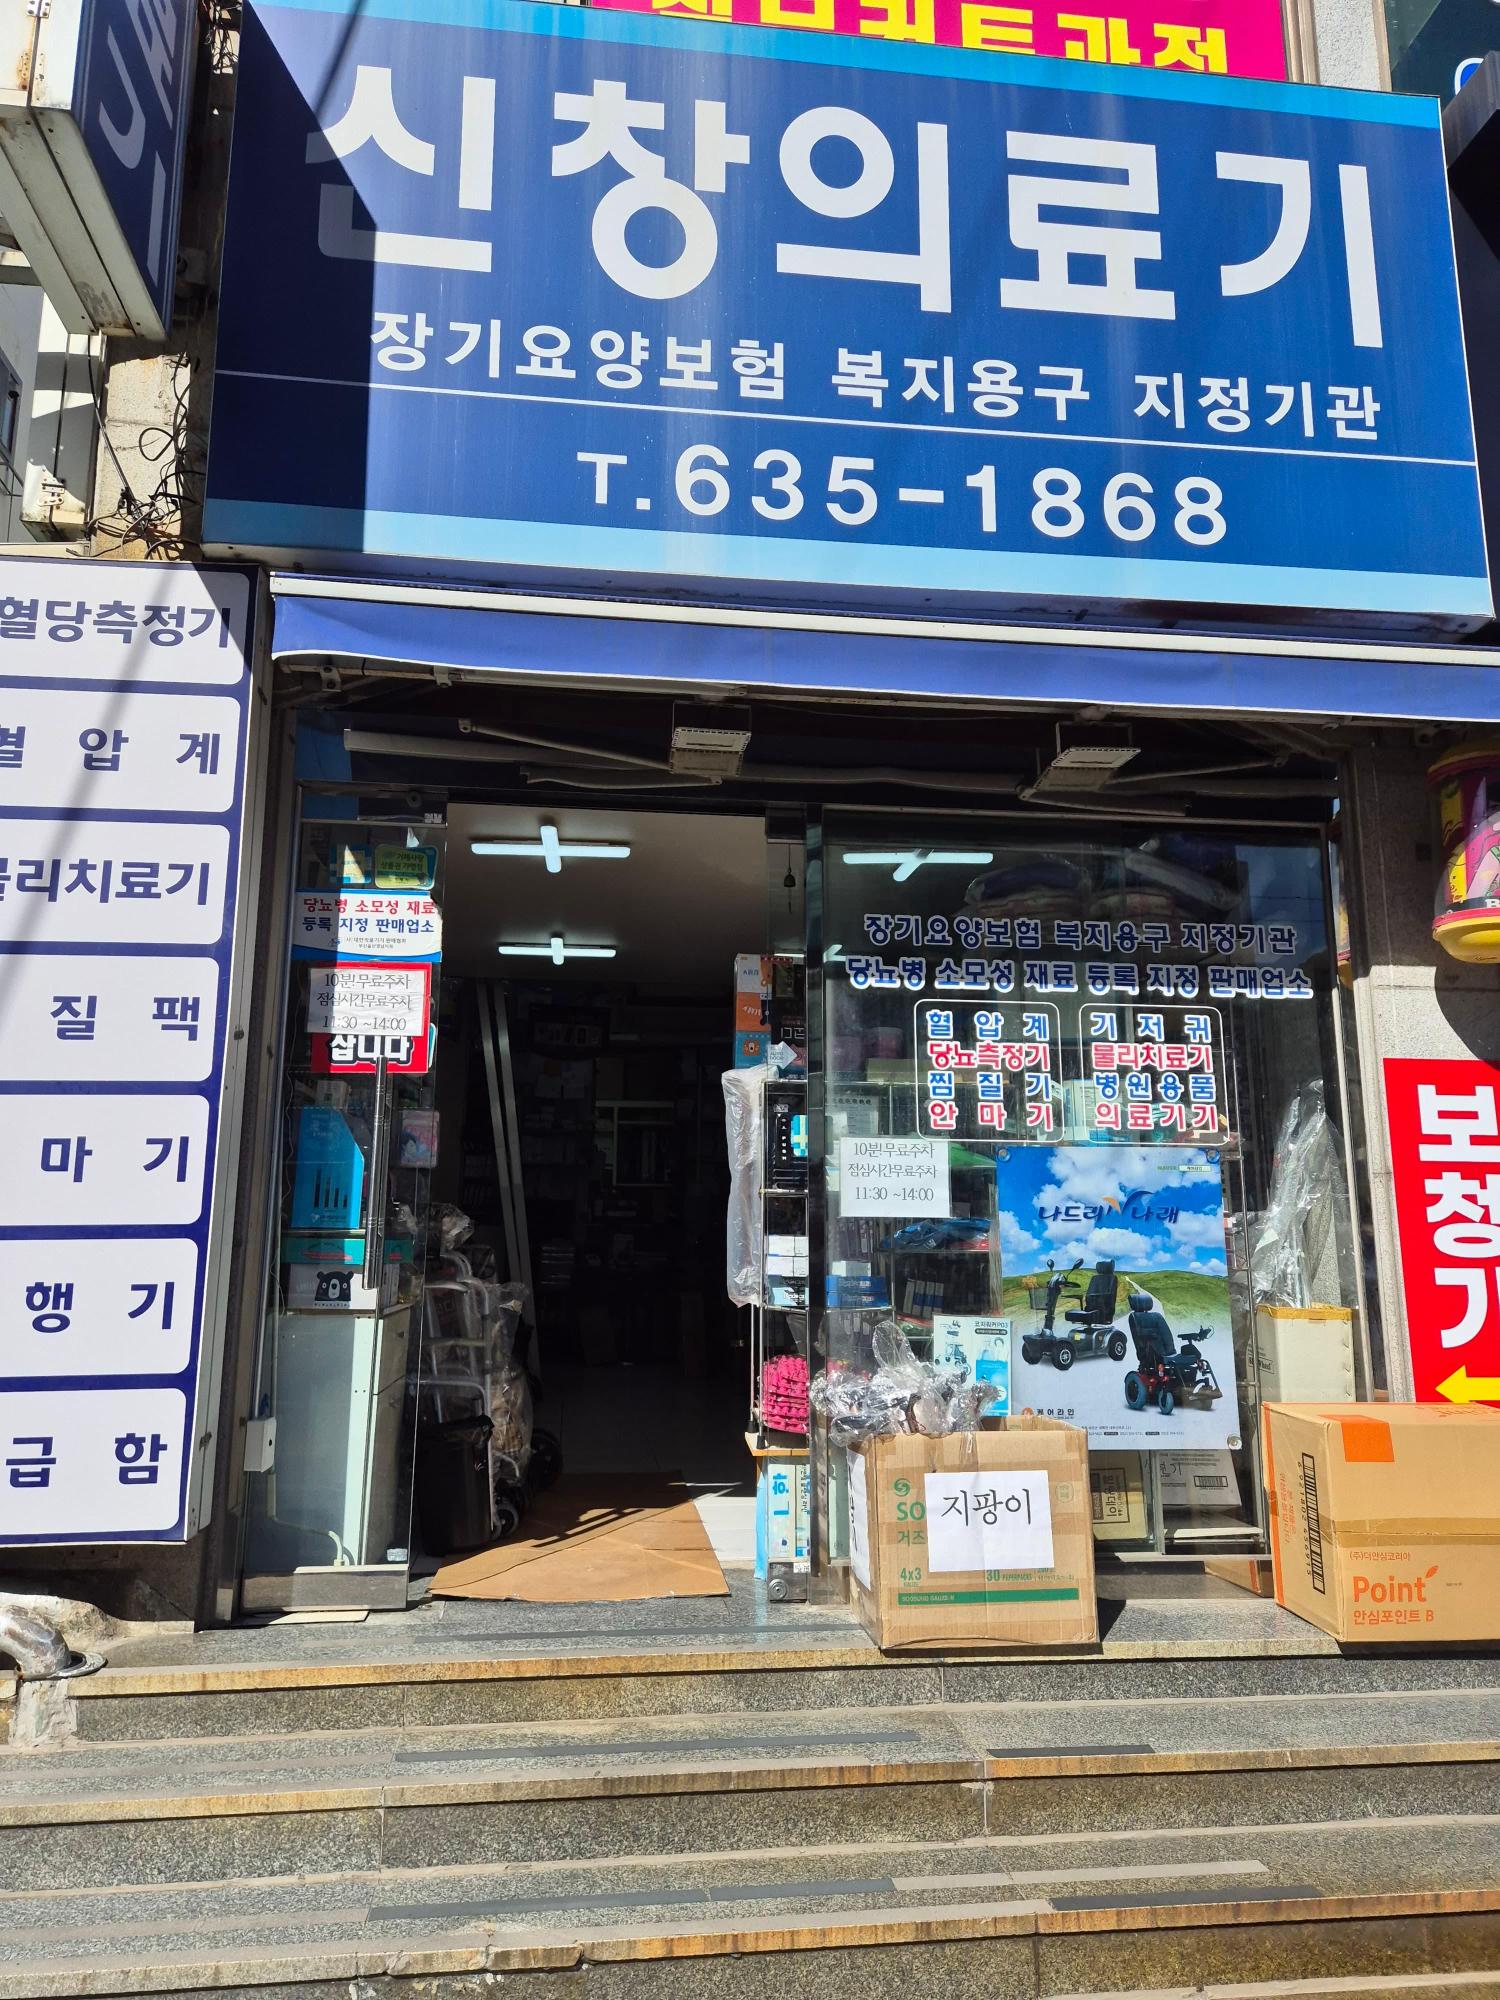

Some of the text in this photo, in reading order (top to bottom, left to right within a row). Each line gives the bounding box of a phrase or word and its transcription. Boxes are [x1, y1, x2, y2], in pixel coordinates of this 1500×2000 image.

[306, 66, 1382, 347] 신창의료기
[371, 312, 1380, 441] 장기요양보험 복지용구 지정기관
[0, 597, 231, 649] 혈당측정기
[0, 857, 209, 905] 리치료기
[303, 898, 435, 915] 당뇨병 소모성 재료
[302, 916, 434, 933] 등록 지정 판매업소
[863, 913, 1296, 956] 장기요양보험 복지용구 지정기관
[845, 956, 1314, 999] 당뇨병 소모성 재료 등록 지정 판매업소
[317, 992, 411, 1011] 점심시간무료주차
[322, 1016, 357, 1029] 11:30
[928, 1041, 1051, 1072] 당뇨측정기
[1092, 1042, 1213, 1073] 물리치료기
[848, 1163, 938, 1179] 점심시간무료주차
[855, 1187, 934, 1201] 11:30 ~14:00
[1417, 1082, 1500, 1349] 보청기
[1037, 1408, 1075, 1416] 케어라인
[941, 1488, 1032, 1526] 지팡이
[900, 1567, 921, 1581] 4x3
[1353, 1575, 1427, 1603] Point
[1353, 1609, 1434, 1625] 안심포인트 B
